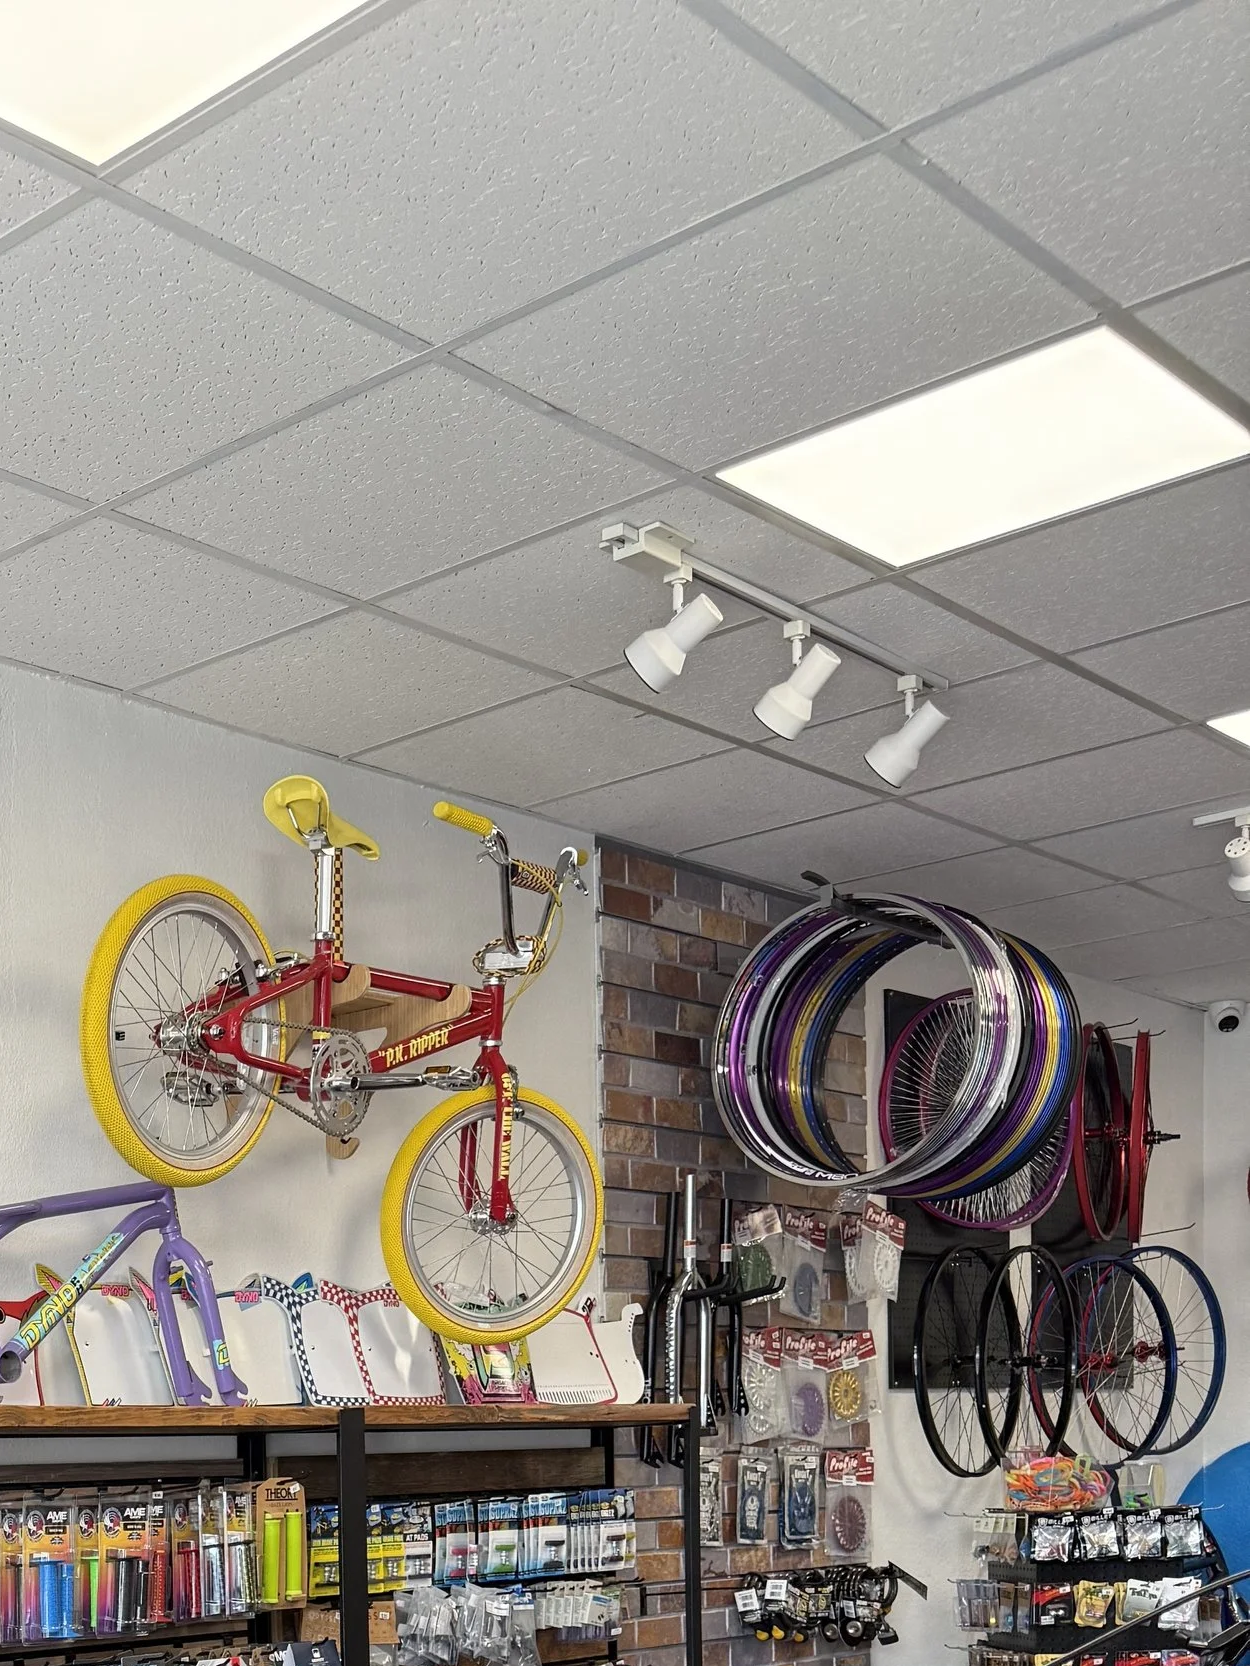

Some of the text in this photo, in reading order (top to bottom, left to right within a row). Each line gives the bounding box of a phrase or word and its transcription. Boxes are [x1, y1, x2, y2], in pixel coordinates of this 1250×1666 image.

[844, 1221, 861, 1239] Prof
[20, 1284, 78, 1350] DYNO
[743, 1333, 766, 1348] ofile
[47, 1511, 68, 1521] AME
[125, 1507, 146, 1517] AME
